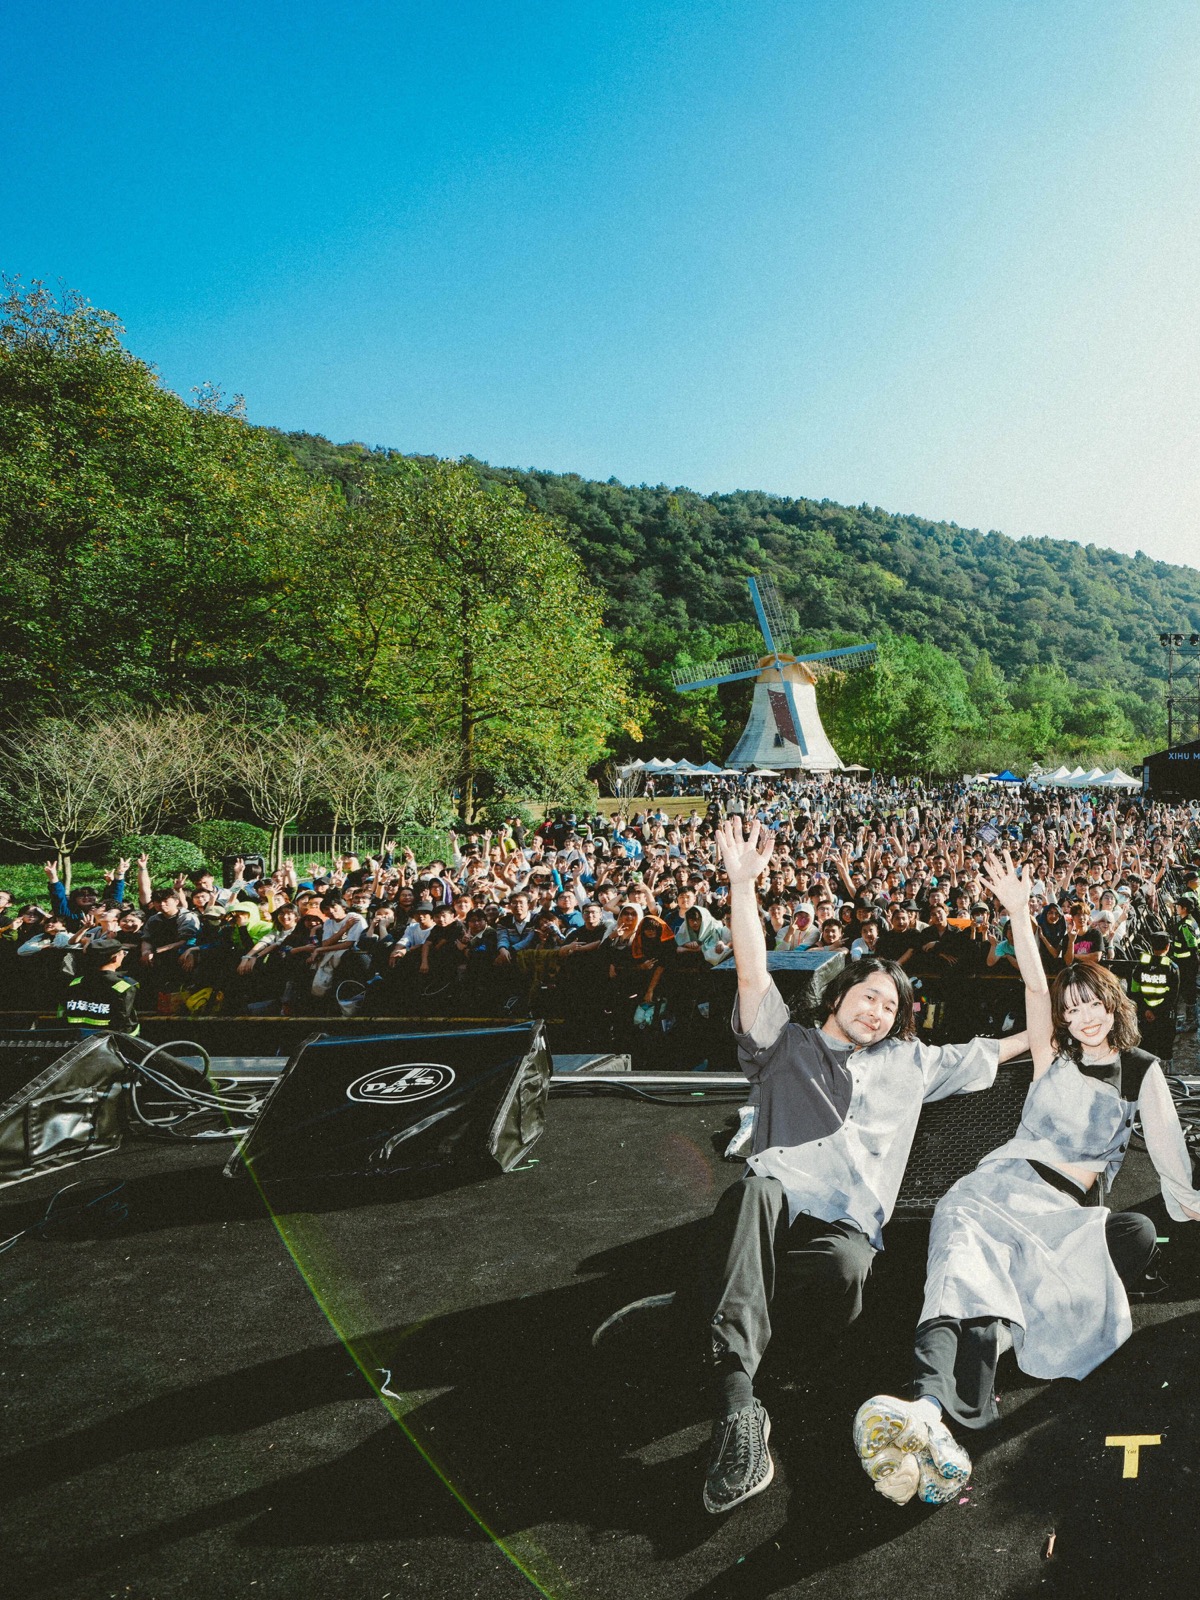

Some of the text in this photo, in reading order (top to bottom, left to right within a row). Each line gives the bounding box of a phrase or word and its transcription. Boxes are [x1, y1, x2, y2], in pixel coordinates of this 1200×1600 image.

[1168, 752, 1190, 760] XIHU
[67, 1000, 110, 1014] 内场安保
